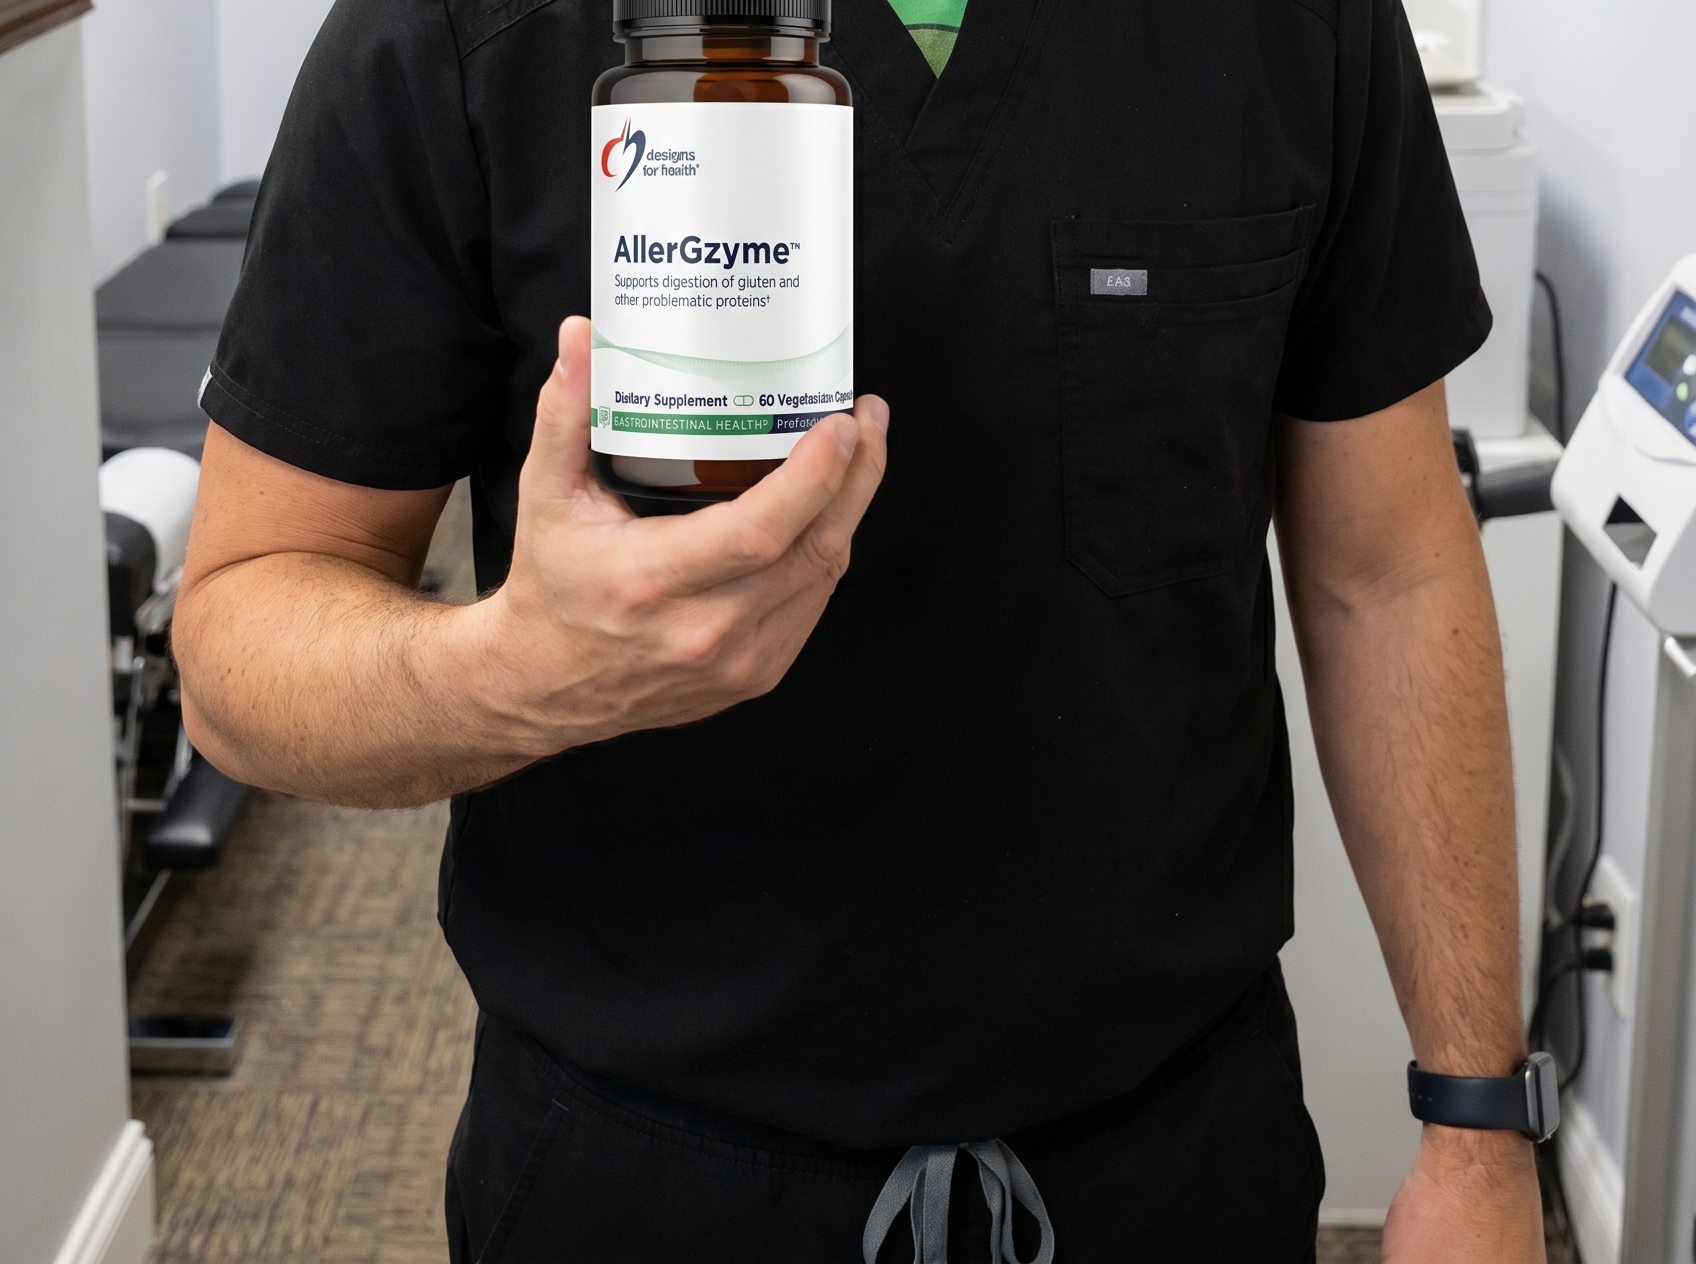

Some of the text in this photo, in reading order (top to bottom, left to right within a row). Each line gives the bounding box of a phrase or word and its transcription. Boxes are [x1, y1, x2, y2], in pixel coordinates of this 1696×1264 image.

[642, 164, 659, 176] for
[614, 274, 659, 289] Supports
[662, 275, 718, 290] digestion
[721, 275, 735, 288] of
[779, 275, 800, 288] and
[614, 293, 640, 305] other
[642, 294, 713, 309] problematic
[654, 393, 728, 409] Supplement
[759, 394, 775, 407] 60
